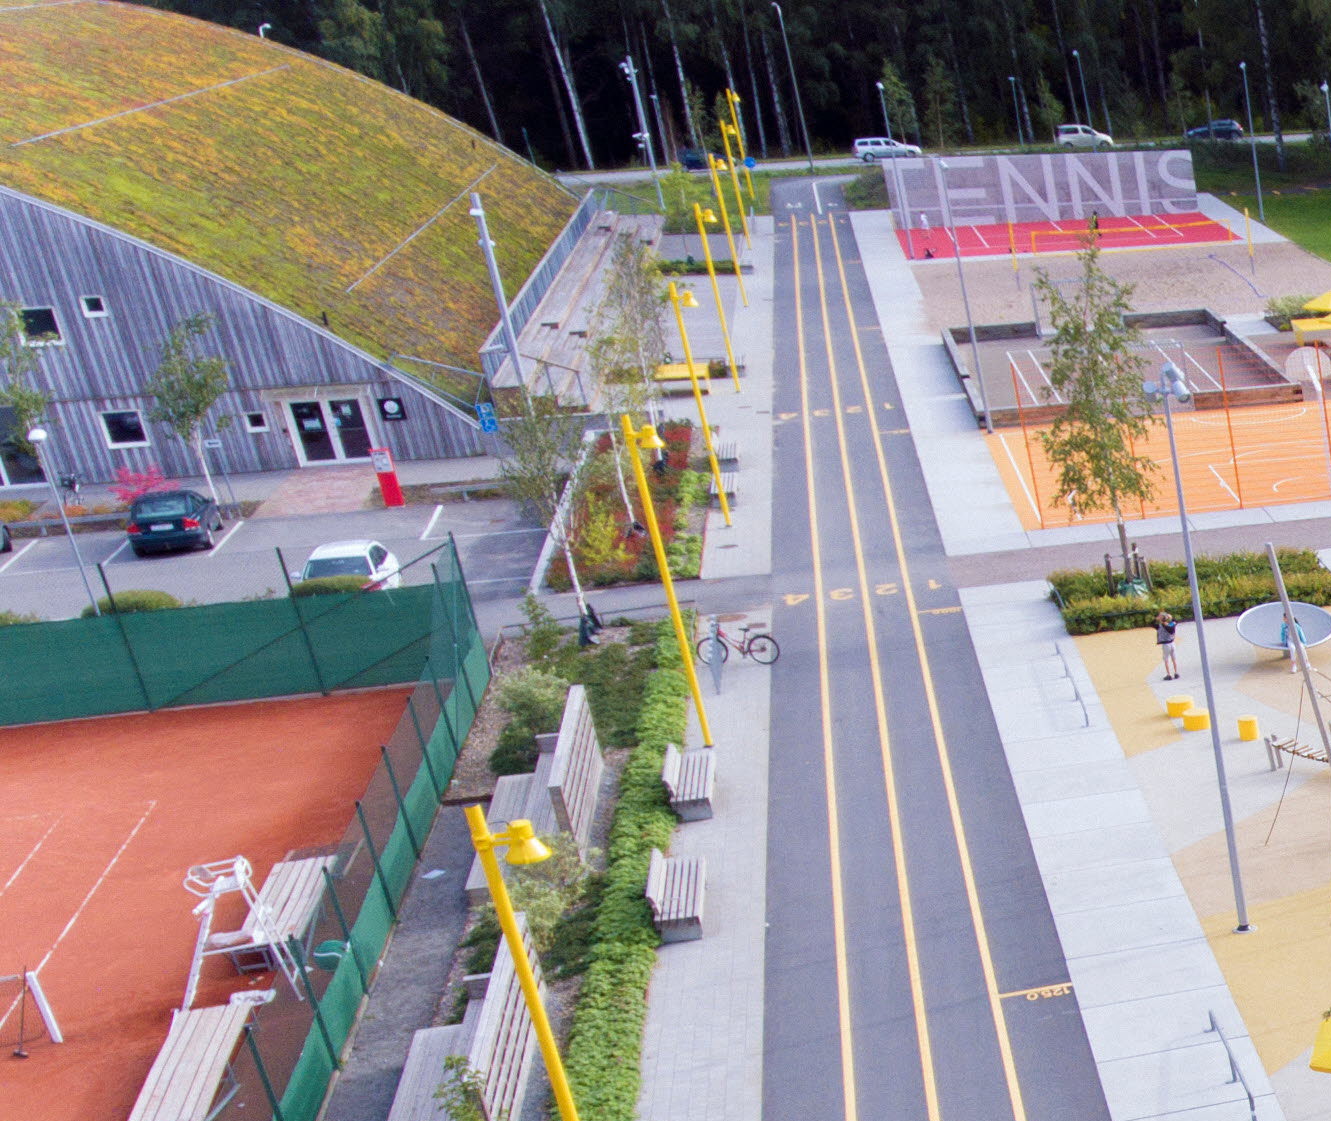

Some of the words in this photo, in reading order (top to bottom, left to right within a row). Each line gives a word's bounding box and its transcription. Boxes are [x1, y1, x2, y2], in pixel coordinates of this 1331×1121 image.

[881, 149, 1200, 231] TENNIS
[830, 587, 854, 600] 3
[875, 582, 898, 595] 2
[784, 593, 810, 606] 4
